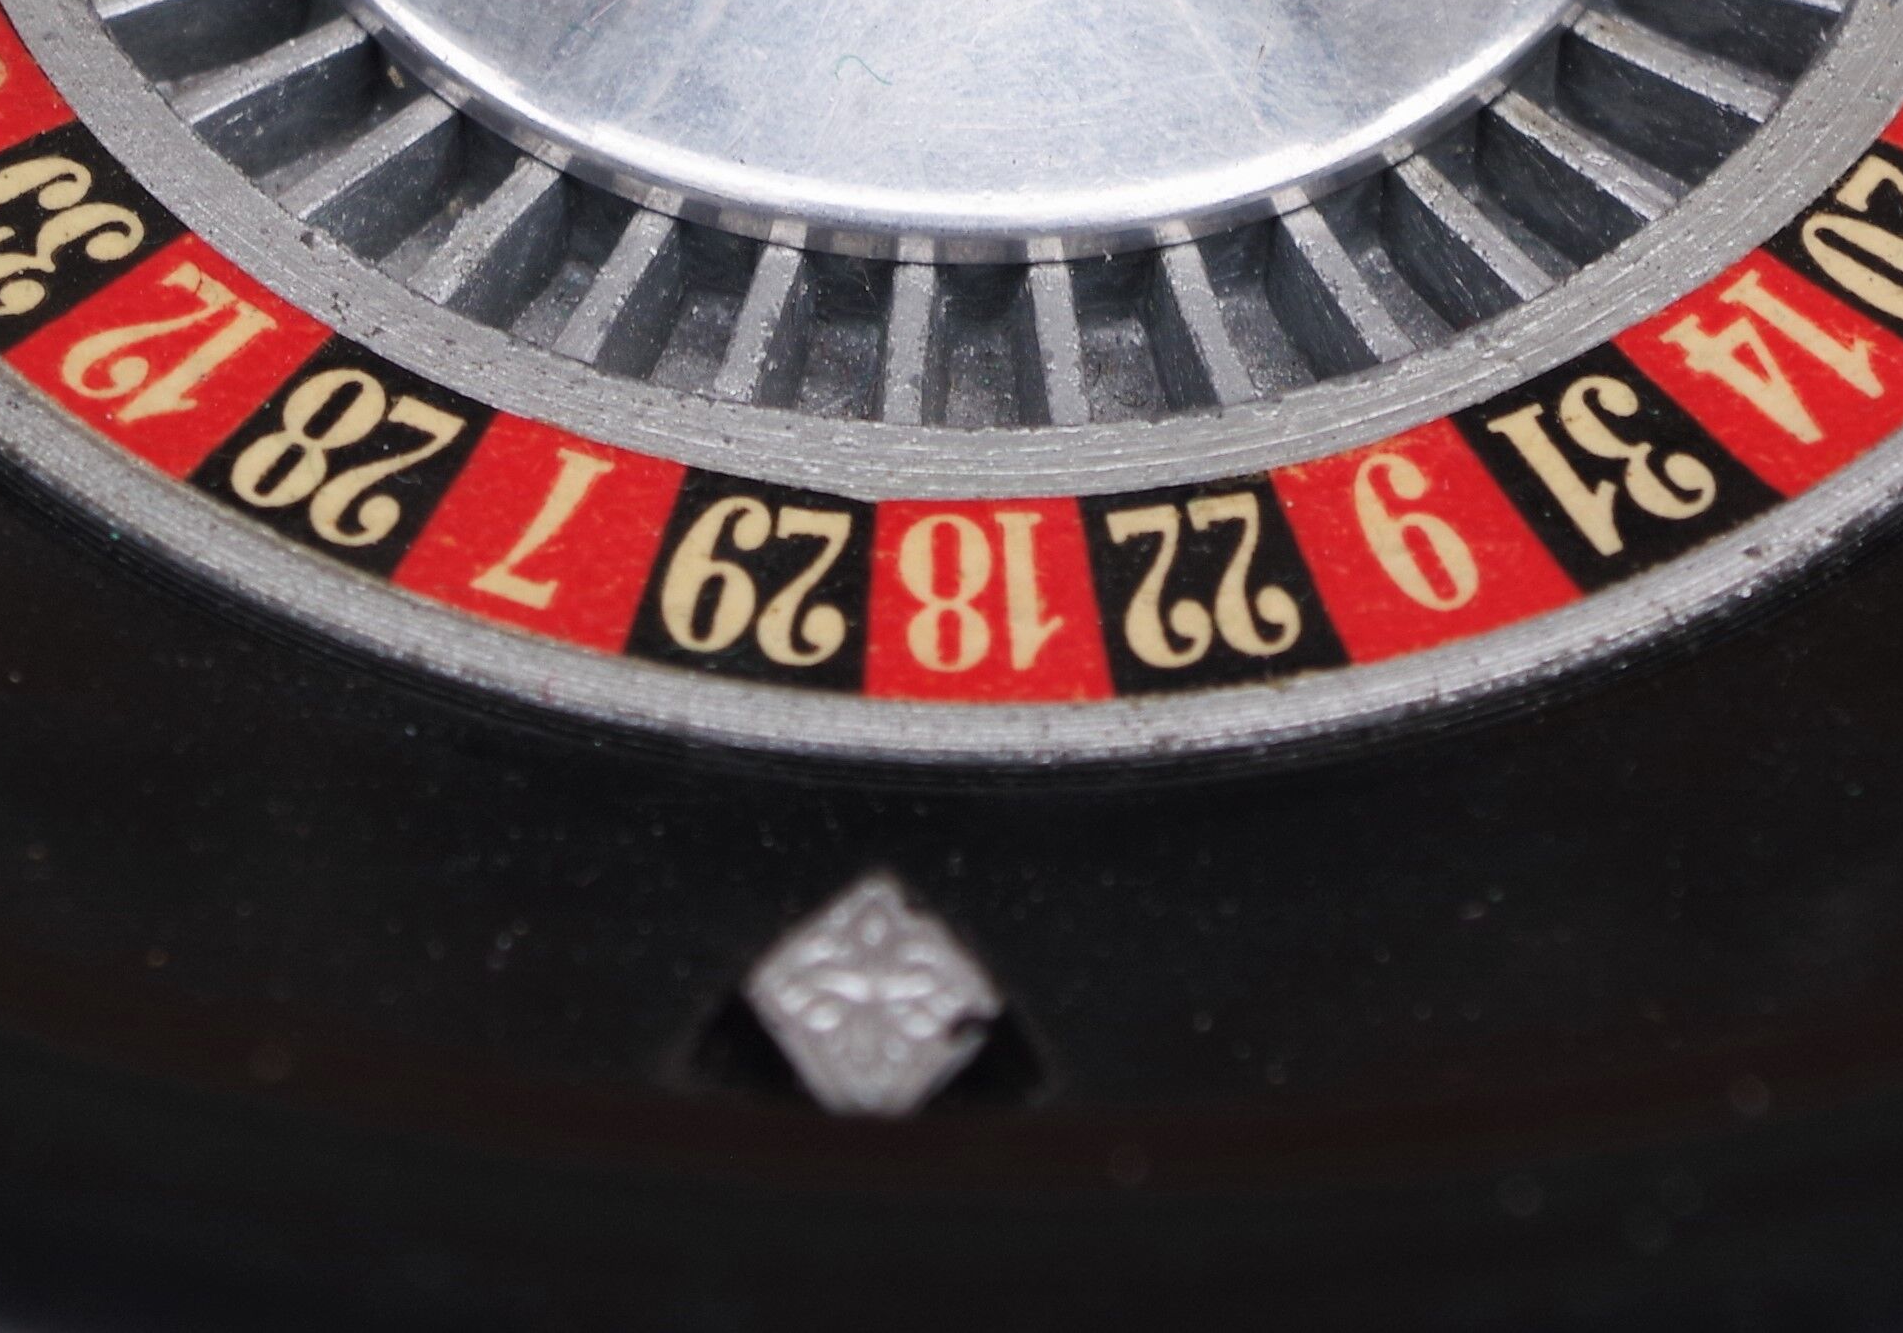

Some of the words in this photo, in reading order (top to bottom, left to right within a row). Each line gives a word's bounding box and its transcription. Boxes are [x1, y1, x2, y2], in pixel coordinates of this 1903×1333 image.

[59, 261, 278, 422] 12
[1661, 266, 1885, 446] 14
[231, 368, 468, 549] 28
[470, 445, 616, 610] 7
[1352, 452, 1481, 614] 9
[1487, 375, 1719, 557] 31
[658, 495, 857, 667] 29
[899, 512, 1064, 674] 18
[1105, 492, 1300, 668] 22
